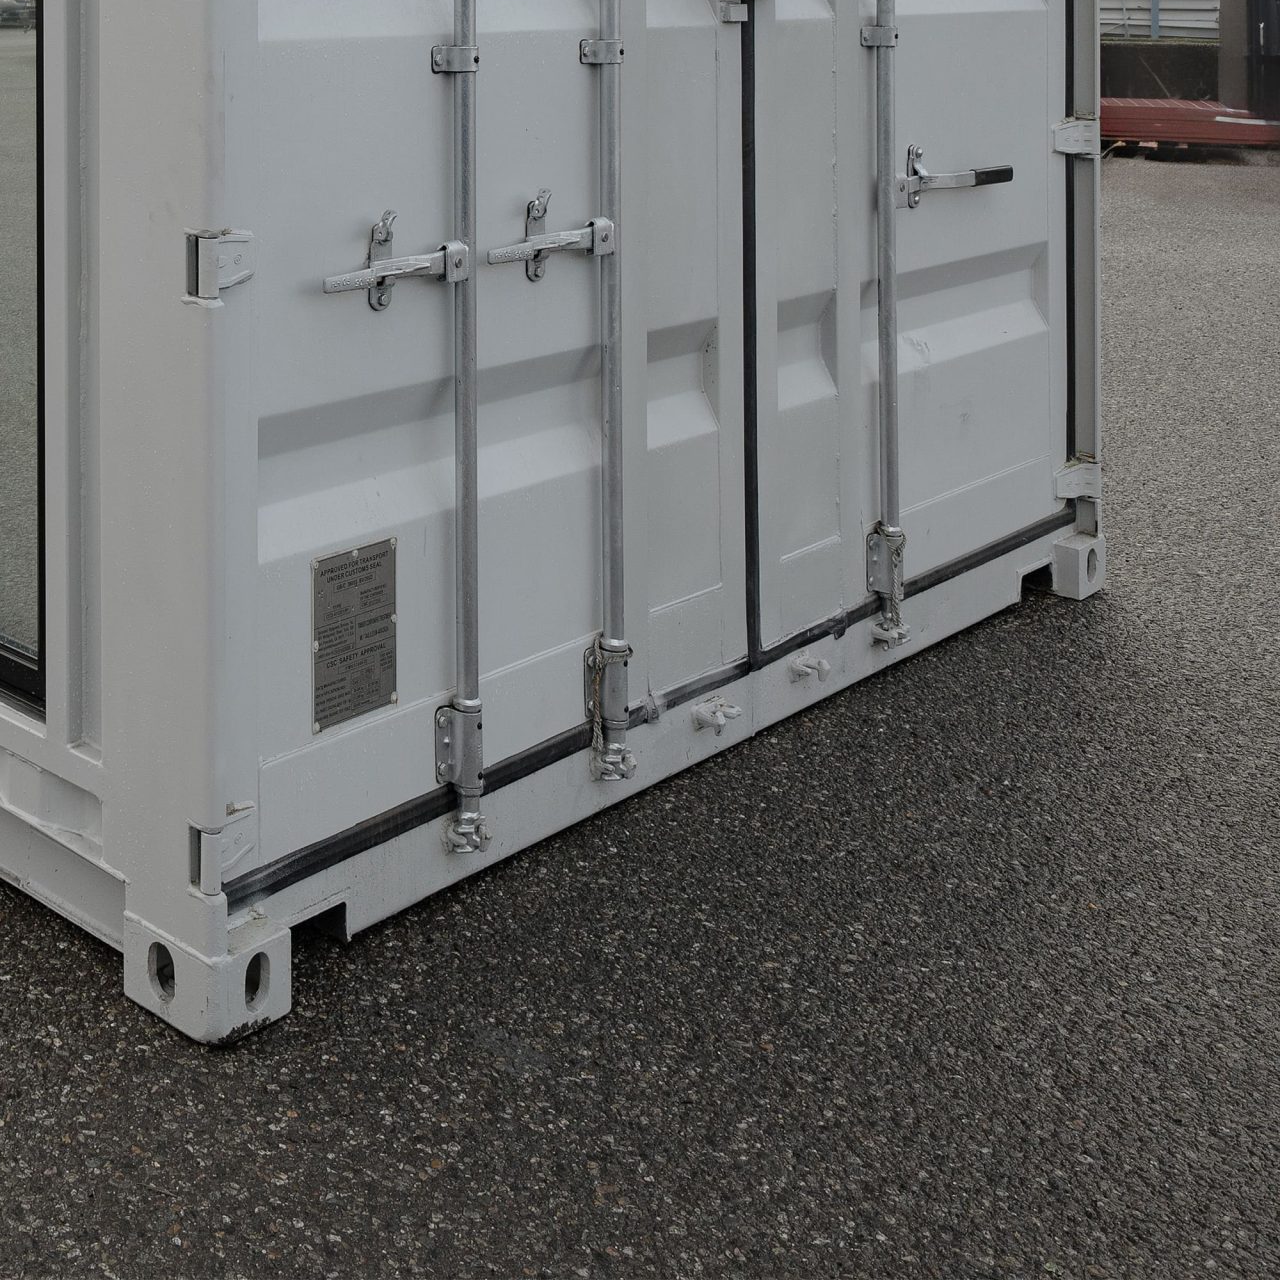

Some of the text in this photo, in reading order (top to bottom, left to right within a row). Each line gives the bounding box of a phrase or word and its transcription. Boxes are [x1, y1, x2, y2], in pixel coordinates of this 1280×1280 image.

[320, 550, 389, 578] APPROVED FOR TRANSPORT
[326, 571, 345, 583] UNDER
[345, 564, 369, 578] CUSTOMS
[326, 660, 337, 669] CSC
[340, 652, 358, 665] SAFETY
[360, 643, 386, 656] APPROVAL
